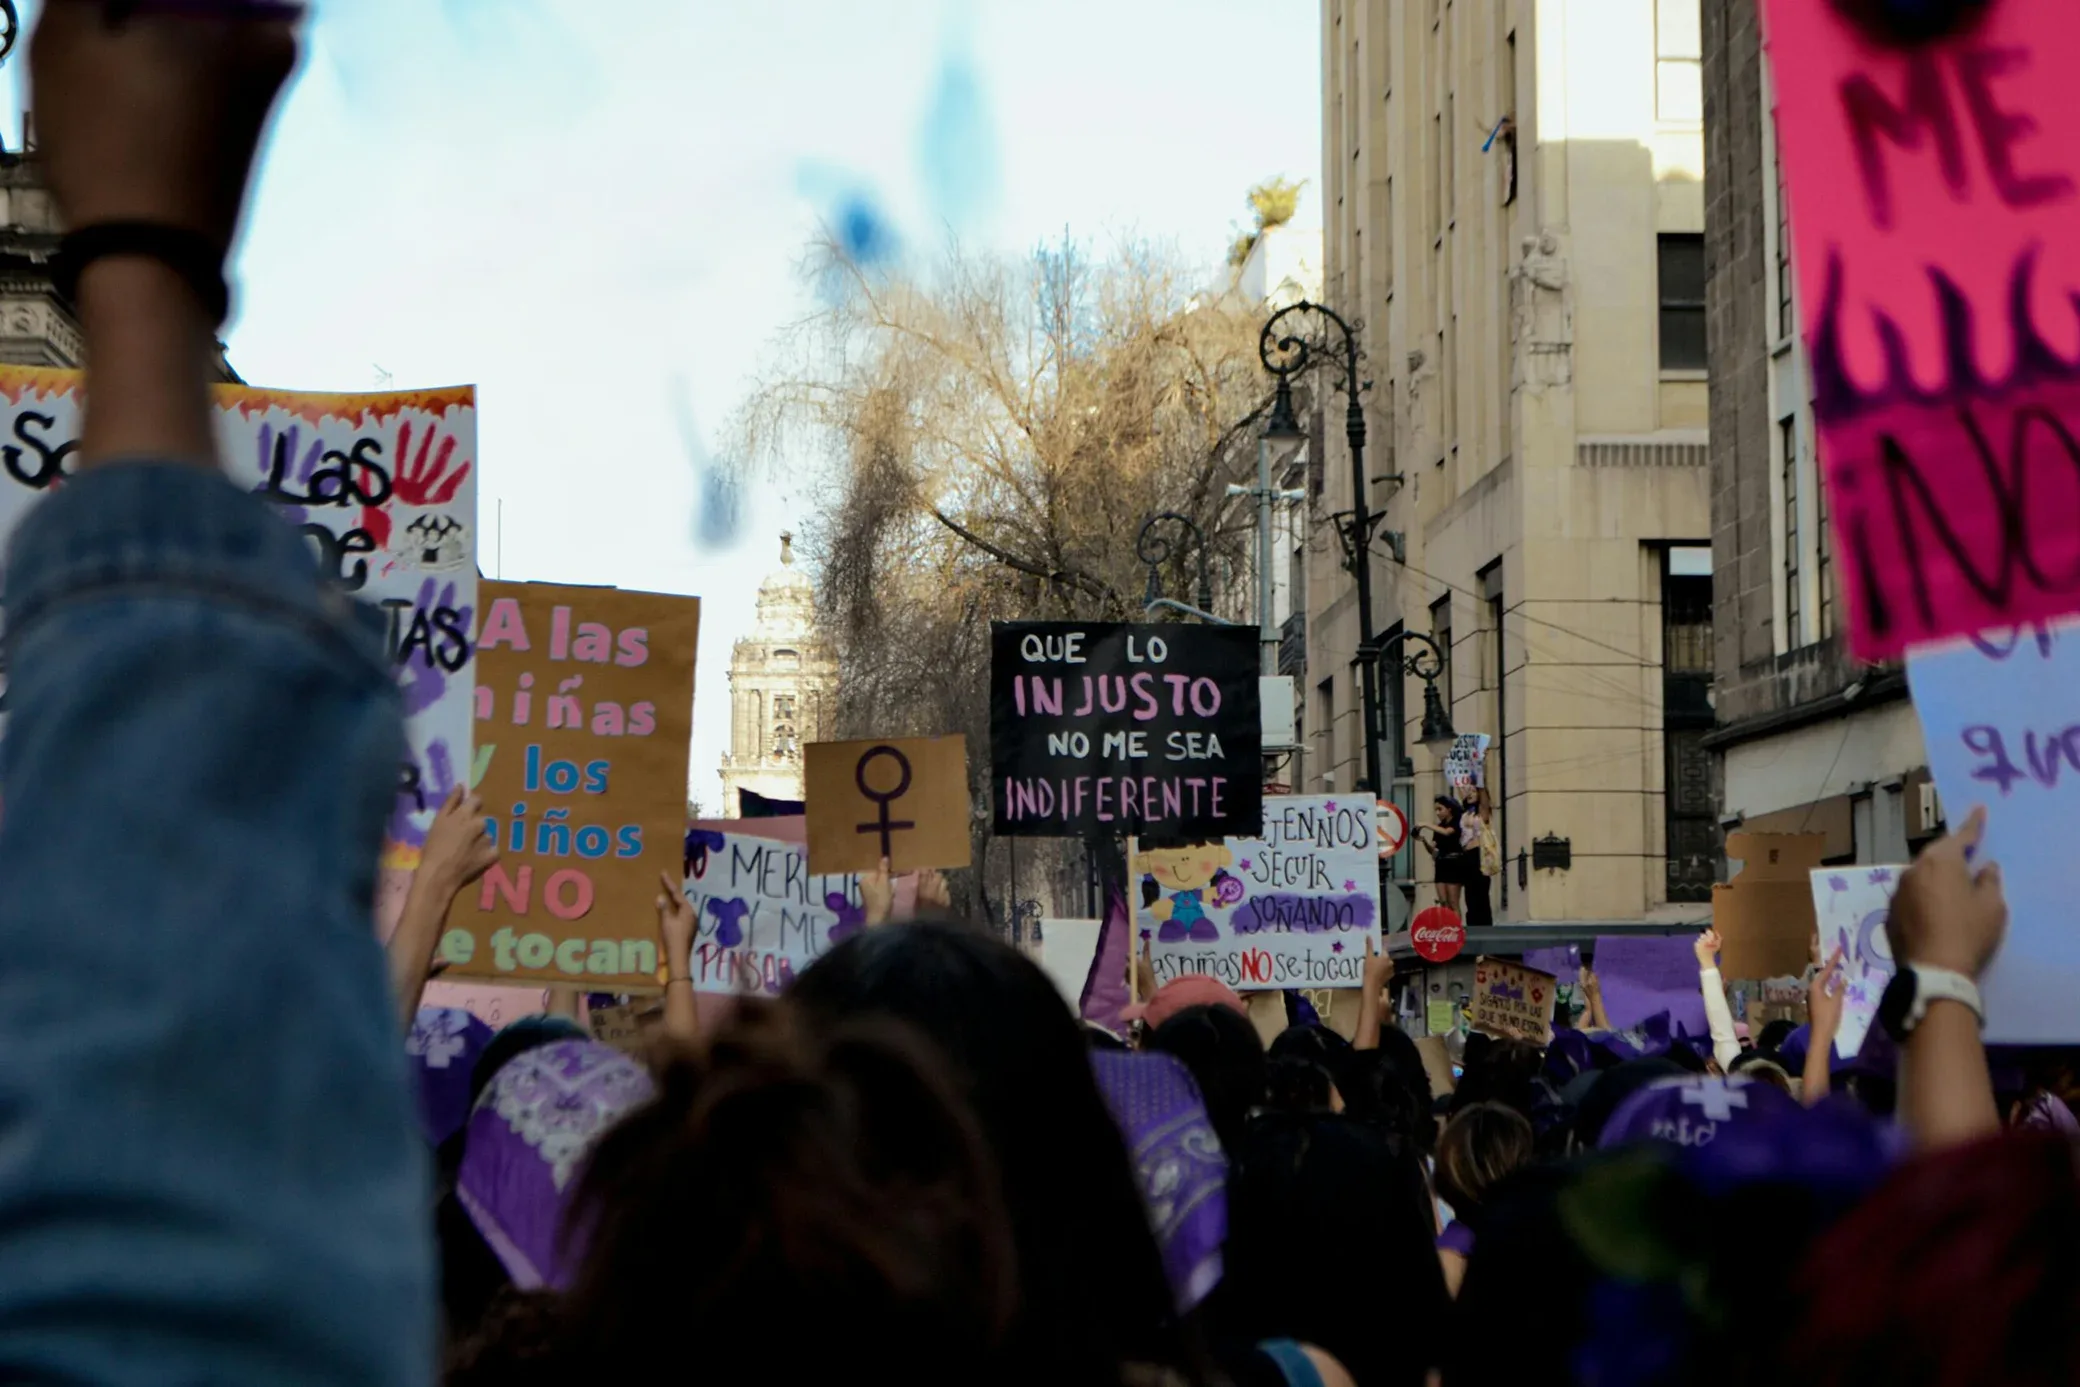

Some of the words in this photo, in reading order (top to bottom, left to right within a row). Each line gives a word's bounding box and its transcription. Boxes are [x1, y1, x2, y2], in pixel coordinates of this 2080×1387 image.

[1838, 46, 2077, 232] ME
[253, 431, 392, 508] Las
[477, 597, 531, 651] A
[549, 605, 650, 667] las
[1020, 632, 1086, 664] QUE
[1127, 635, 1168, 663] LO
[1014, 672, 1222, 720] INJUSTO
[524, 744, 610, 794] los
[1048, 731, 1090, 759] NO
[1102, 731, 1148, 760] ME
[1165, 732, 1225, 760] SEA
[1006, 776, 1228, 822] INDIFERENTE
[478, 864, 594, 920] NO
[1252, 850, 1334, 891] SEGUIR
[1243, 895, 1355, 935] SOÑANDO
[490, 927, 658, 975] tocan
[1178, 950, 1241, 986] niñas
[1241, 946, 1272, 984] NO
[1275, 951, 1303, 982] se
[1478, 1009, 1495, 1024] QUE
